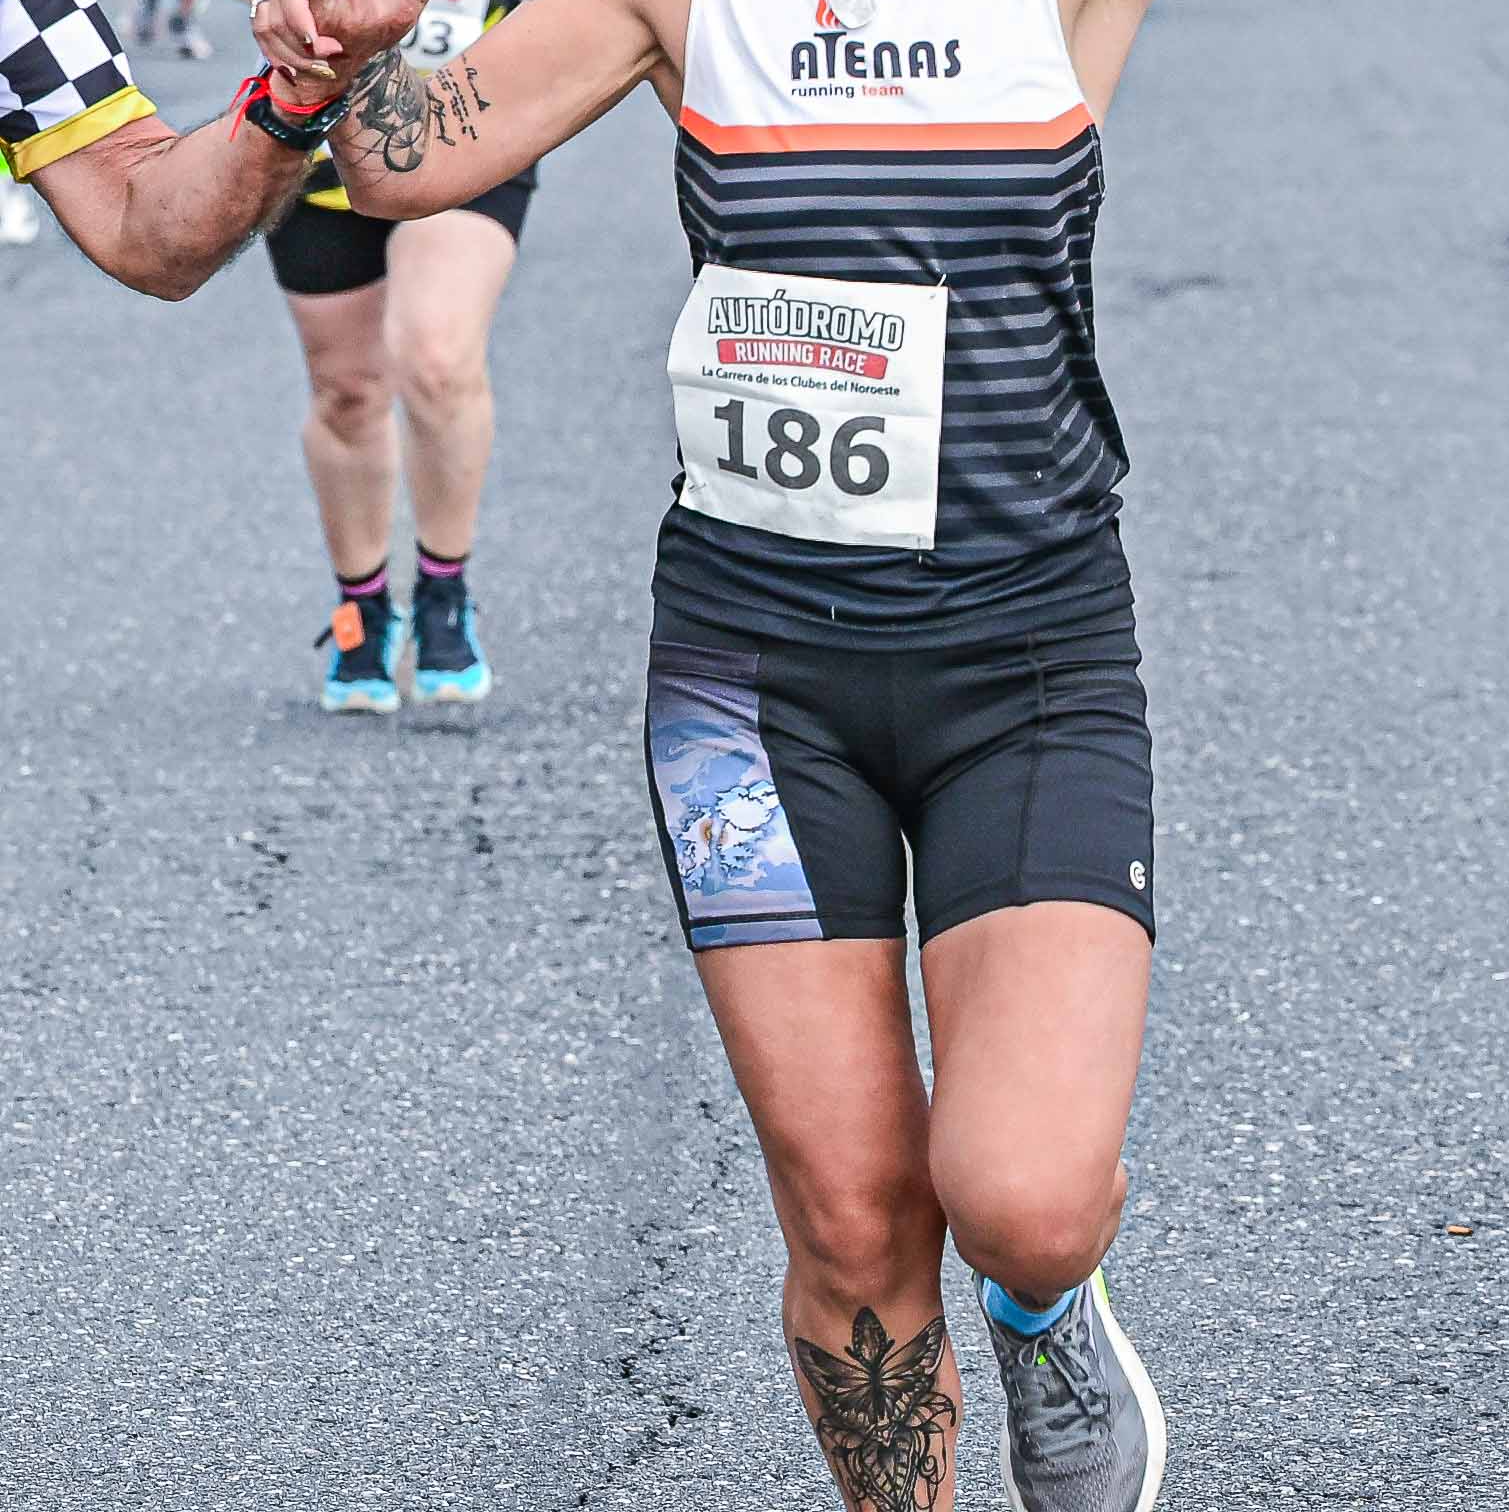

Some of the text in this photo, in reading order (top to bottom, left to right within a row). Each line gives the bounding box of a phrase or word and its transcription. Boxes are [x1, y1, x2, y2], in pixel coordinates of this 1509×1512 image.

[791, 32, 962, 80] ATENAS
[791, 83, 905, 99] running team
[708, 289, 905, 352] AUTÓDROMO
[735, 341, 868, 375] RUNNING RACE
[702, 366, 901, 397] La Carrera de los Clubes del Noroeste
[714, 398, 890, 497] 186
